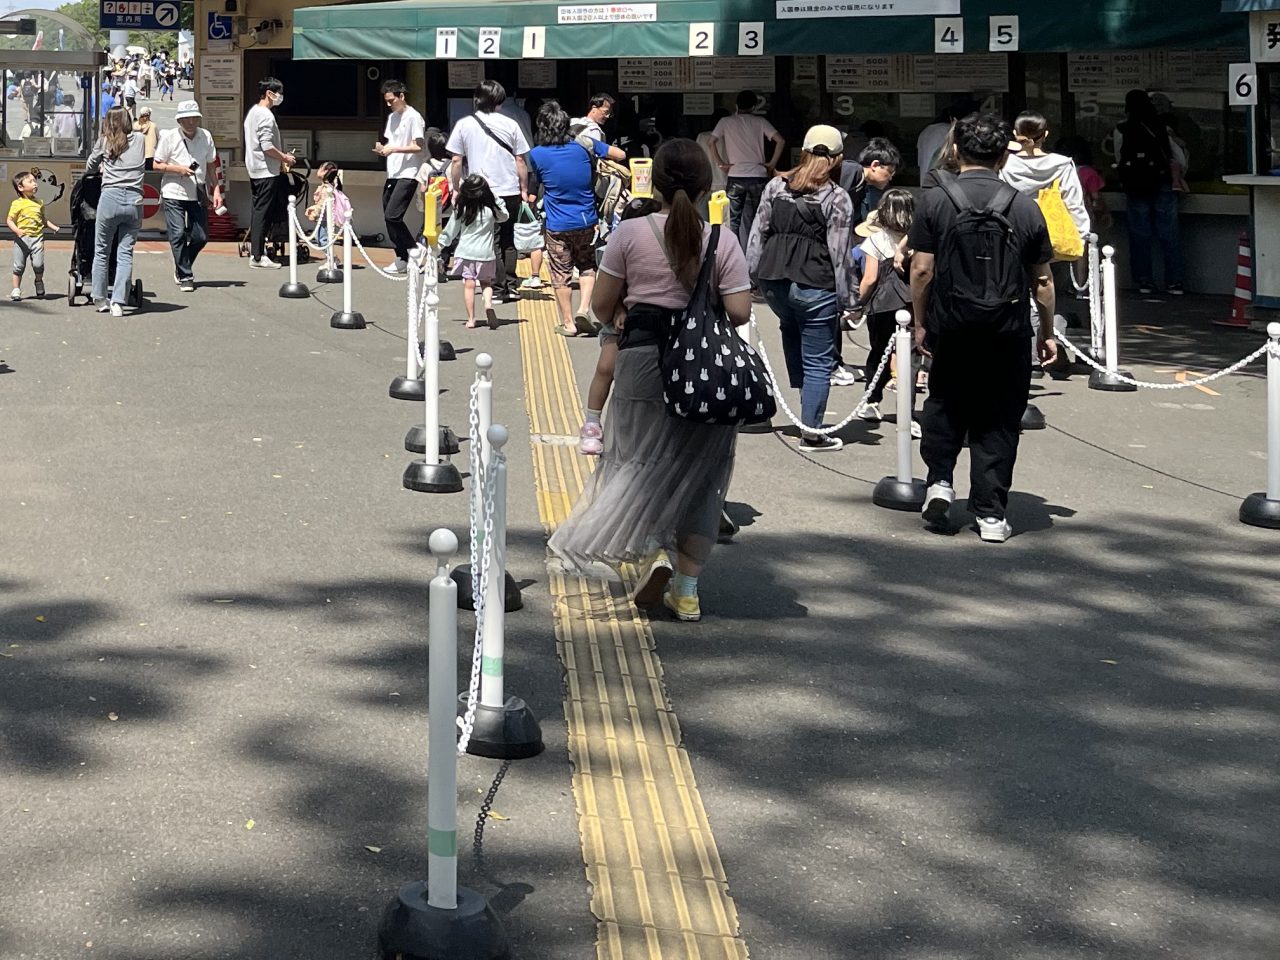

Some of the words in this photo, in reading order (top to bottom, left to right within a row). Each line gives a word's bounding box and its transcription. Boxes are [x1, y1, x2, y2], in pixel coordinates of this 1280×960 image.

[531, 32, 536, 50] 1
[695, 31, 709, 49] 2
[744, 30, 759, 49] 3
[940, 26, 959, 46] 4
[997, 25, 1013, 44] 5
[444, 38, 449, 55] 1
[483, 37, 495, 54] 2
[1235, 73, 1252, 97] 6
[631, 95, 639, 114] 1
[752, 96, 768, 114] 2
[835, 95, 855, 116] 3
[979, 95, 999, 115] 4
[1076, 97, 1100, 118] 5
